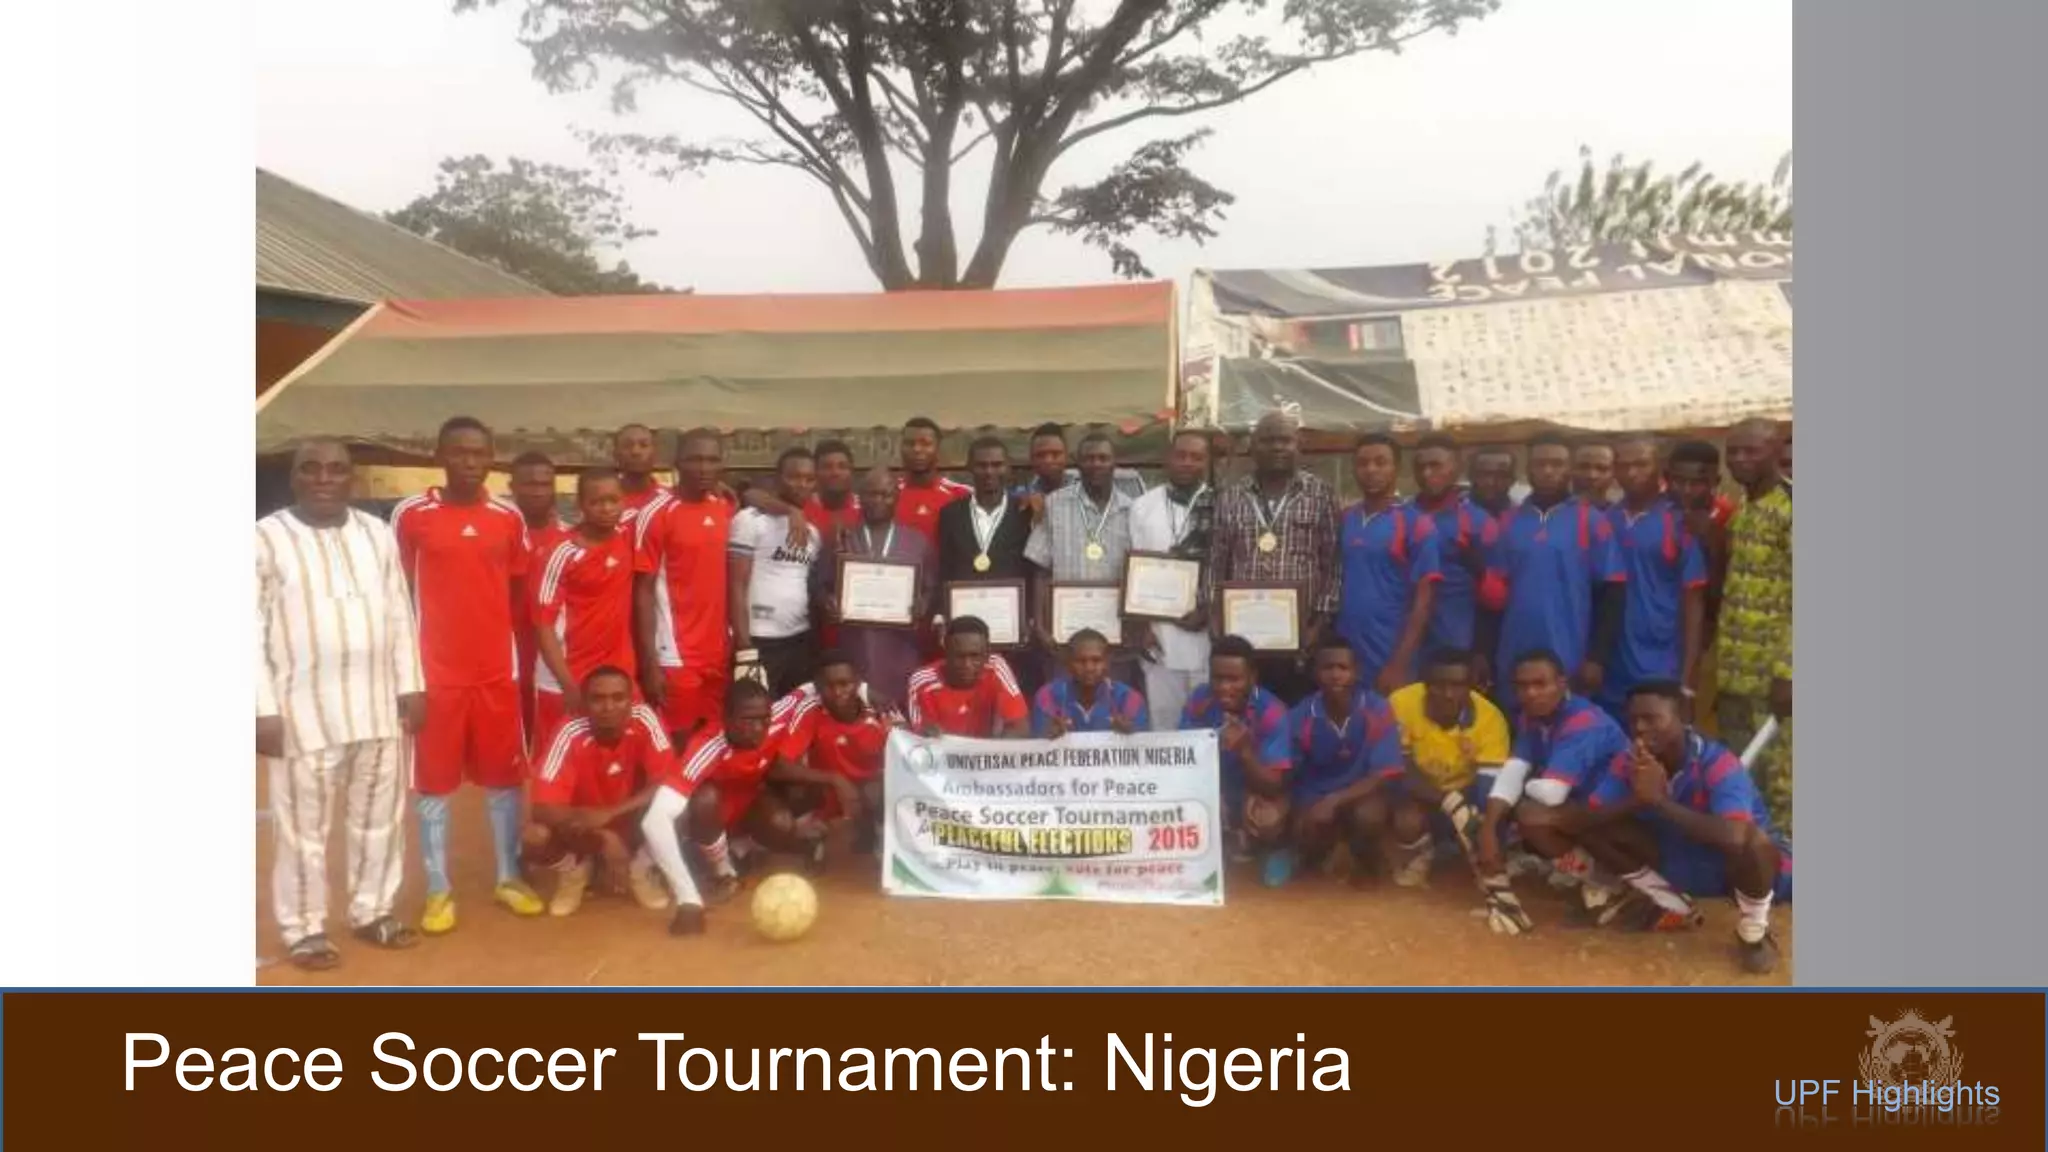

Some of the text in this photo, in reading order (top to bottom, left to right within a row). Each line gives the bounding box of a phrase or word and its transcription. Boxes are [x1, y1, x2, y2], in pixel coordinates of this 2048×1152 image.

[1427, 249, 1792, 301] ONAL PEACE
[945, 746, 1197, 771] UNIVERSAL PEACE FEDERATION NIGERIA
[943, 776, 1159, 797] Ambassadors for Peace
[915, 801, 1184, 826] Peace Soccer Tournament
[1030, 827, 1133, 855] ELECTIONS
[1147, 823, 1200, 851] 2015
